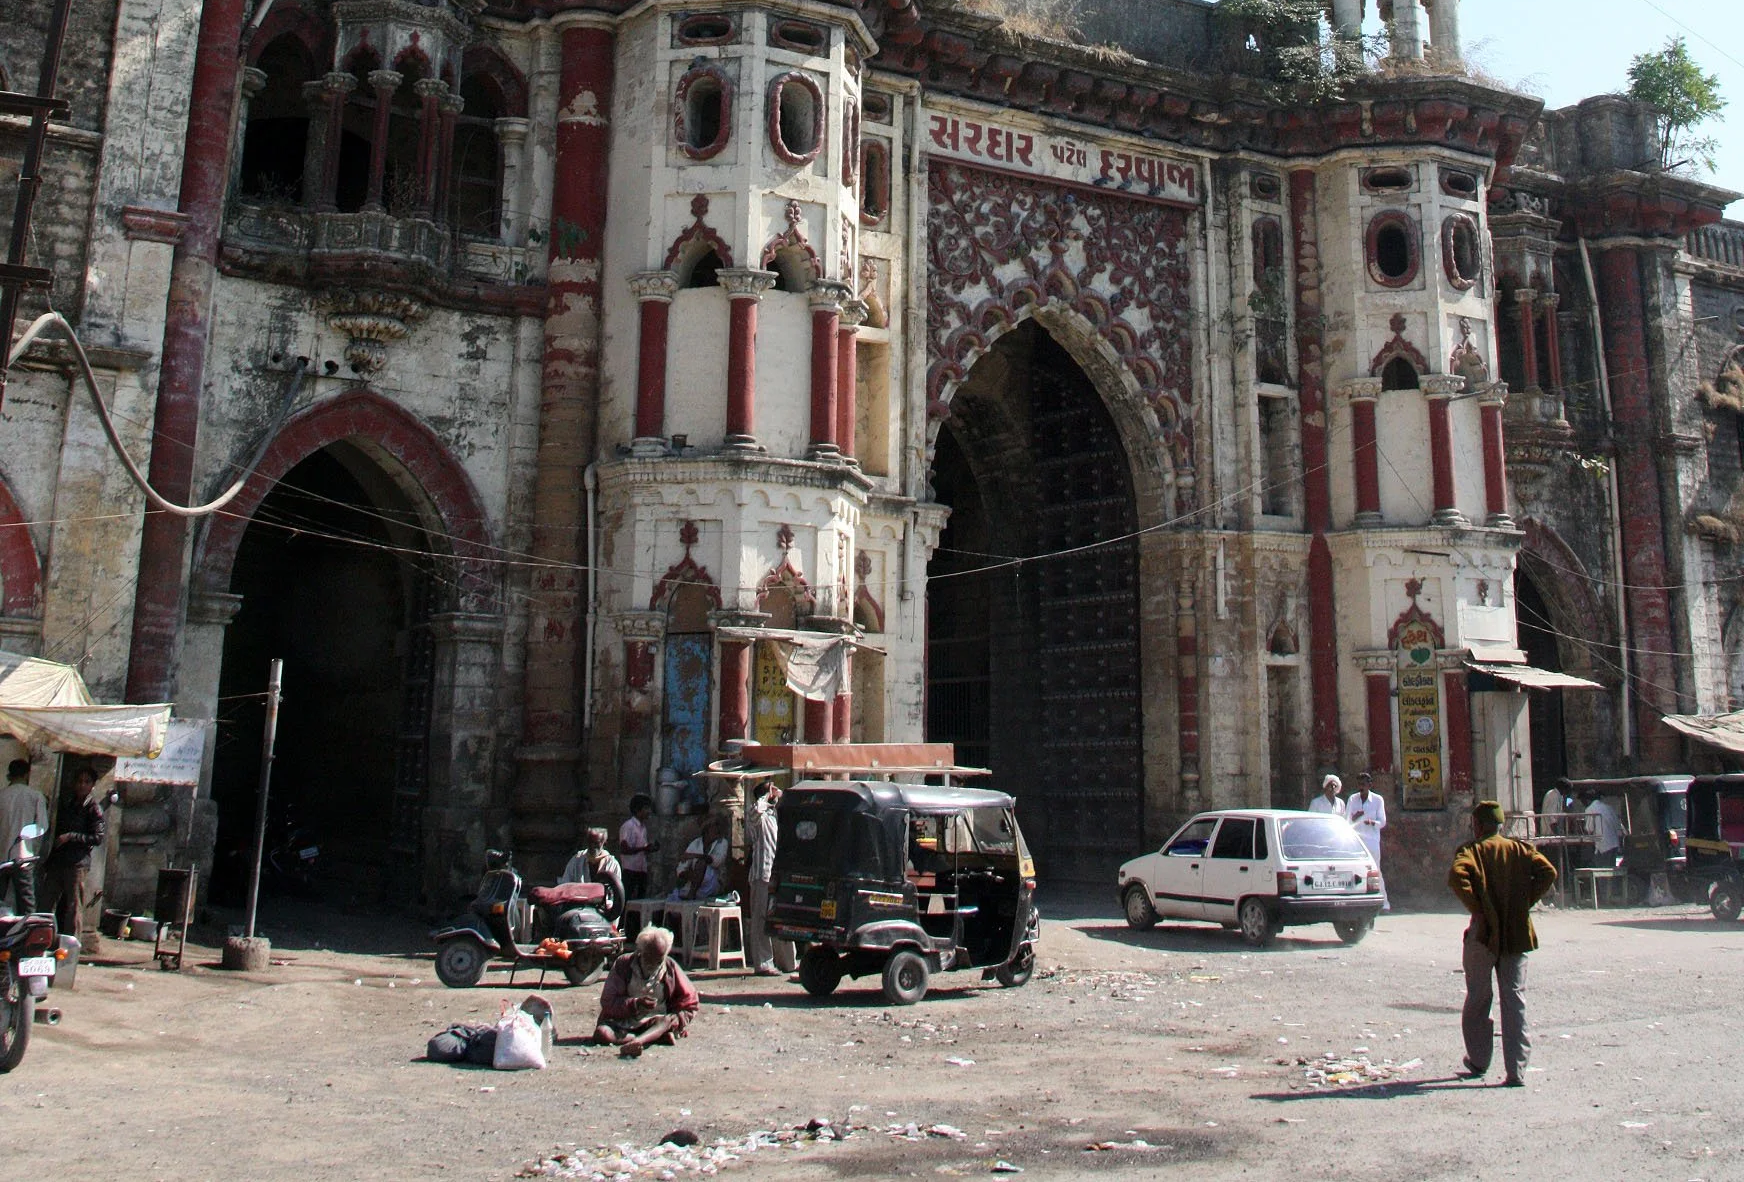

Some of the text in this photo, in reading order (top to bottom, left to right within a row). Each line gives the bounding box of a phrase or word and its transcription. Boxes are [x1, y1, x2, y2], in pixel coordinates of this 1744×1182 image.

[928, 114, 1034, 167] સરદાર
[1050, 141, 1087, 168] પટેલ
[1408, 757, 1431, 770] STD
